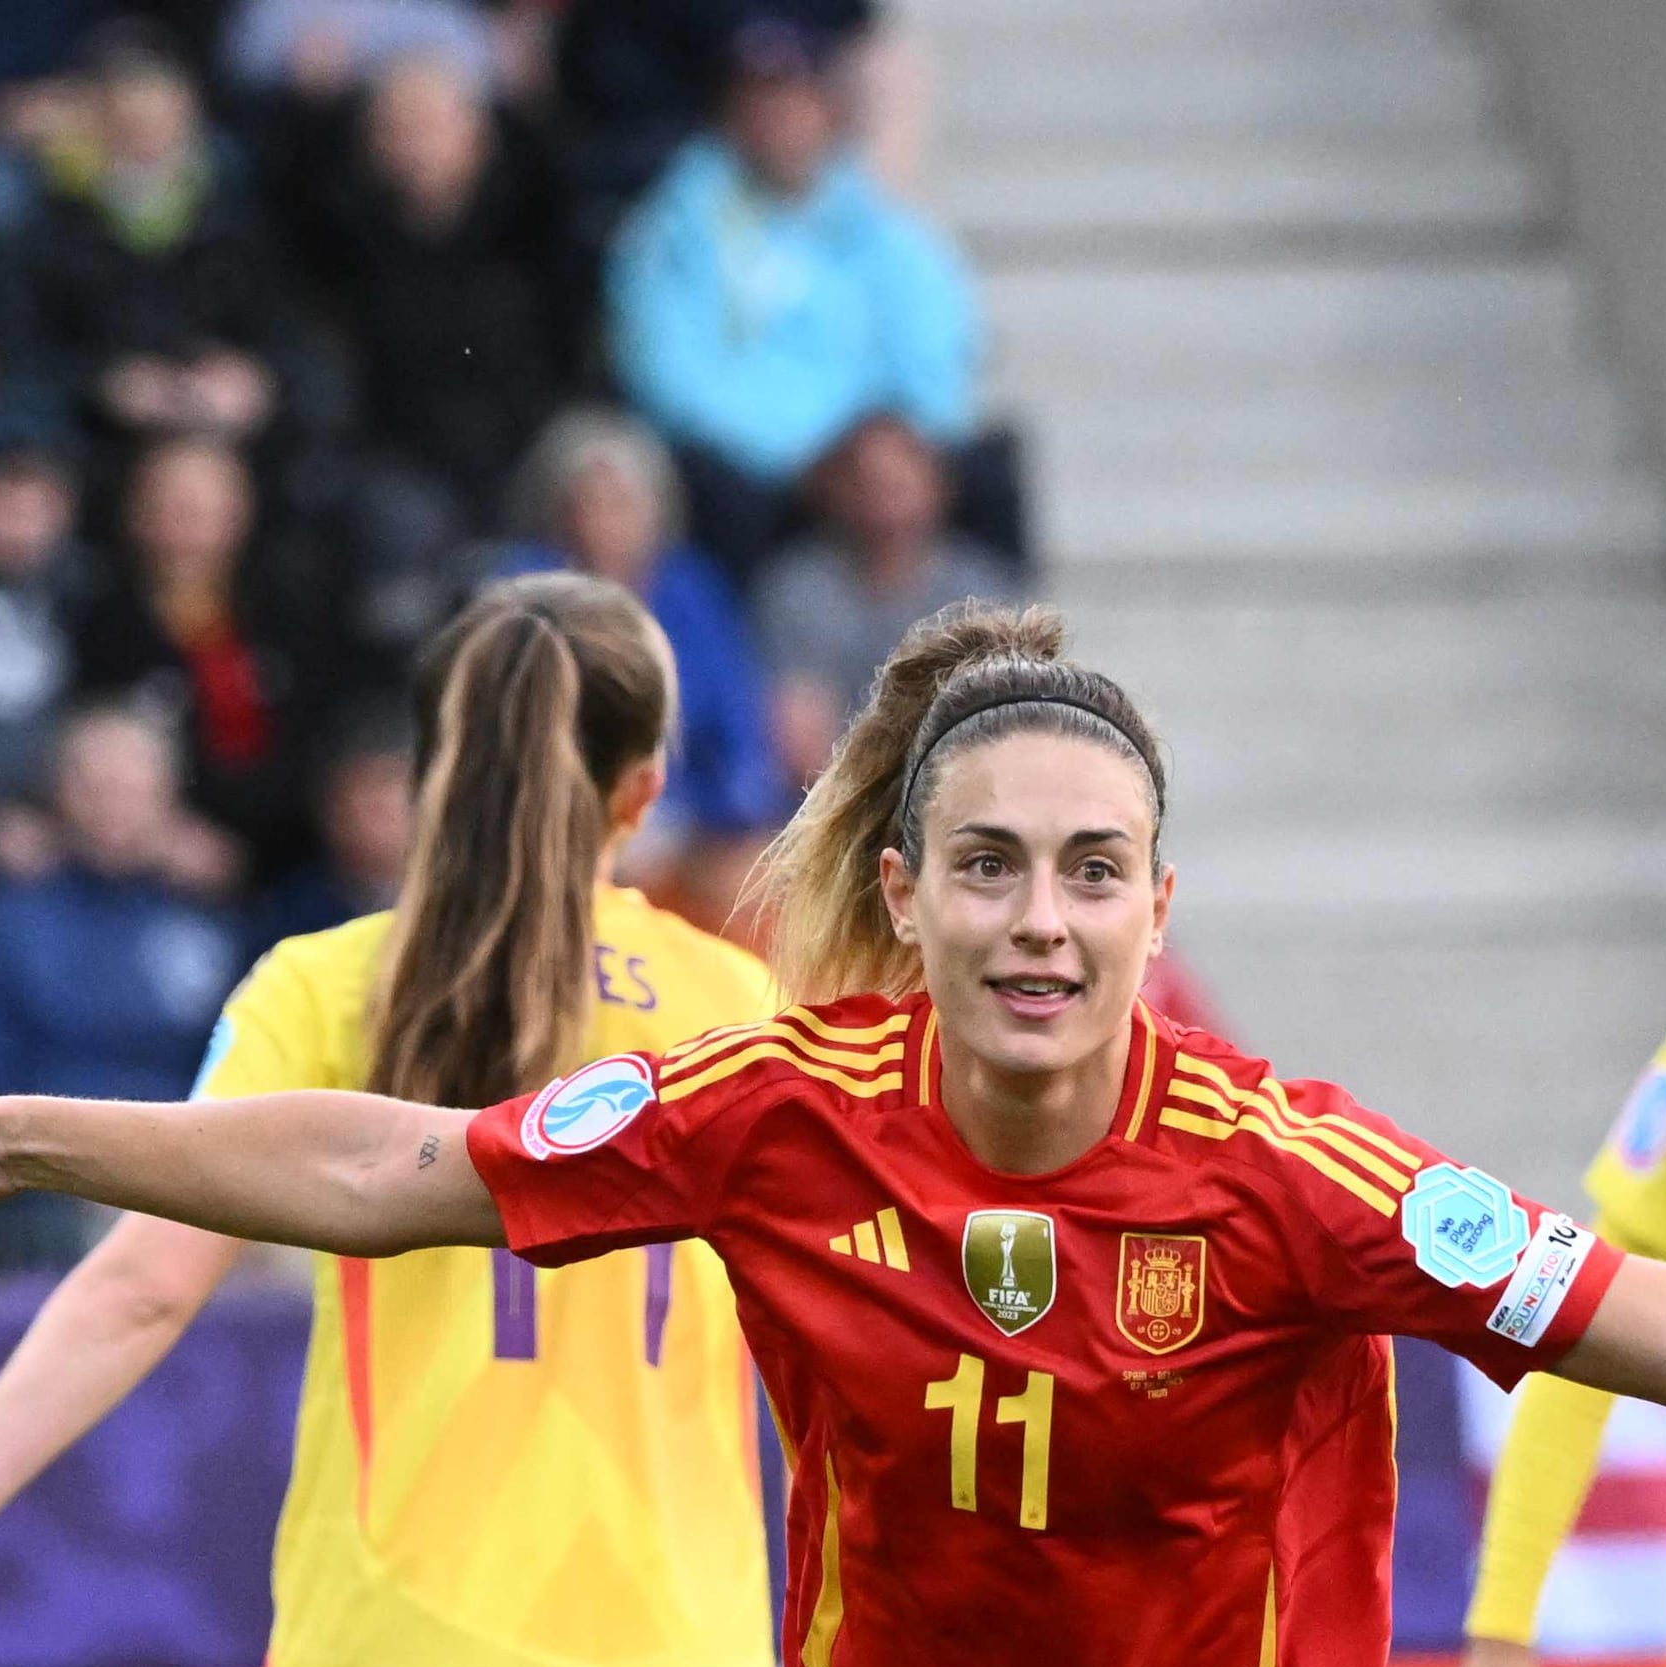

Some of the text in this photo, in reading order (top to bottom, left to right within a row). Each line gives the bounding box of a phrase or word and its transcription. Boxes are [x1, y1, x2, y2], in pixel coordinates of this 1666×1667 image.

[594, 943, 657, 1010] ES
[1436, 1216, 1456, 1235] We
[1461, 1212, 1494, 1253] Strong
[1491, 1305, 1511, 1330] UEFA
[924, 1352, 1055, 1531] 11
